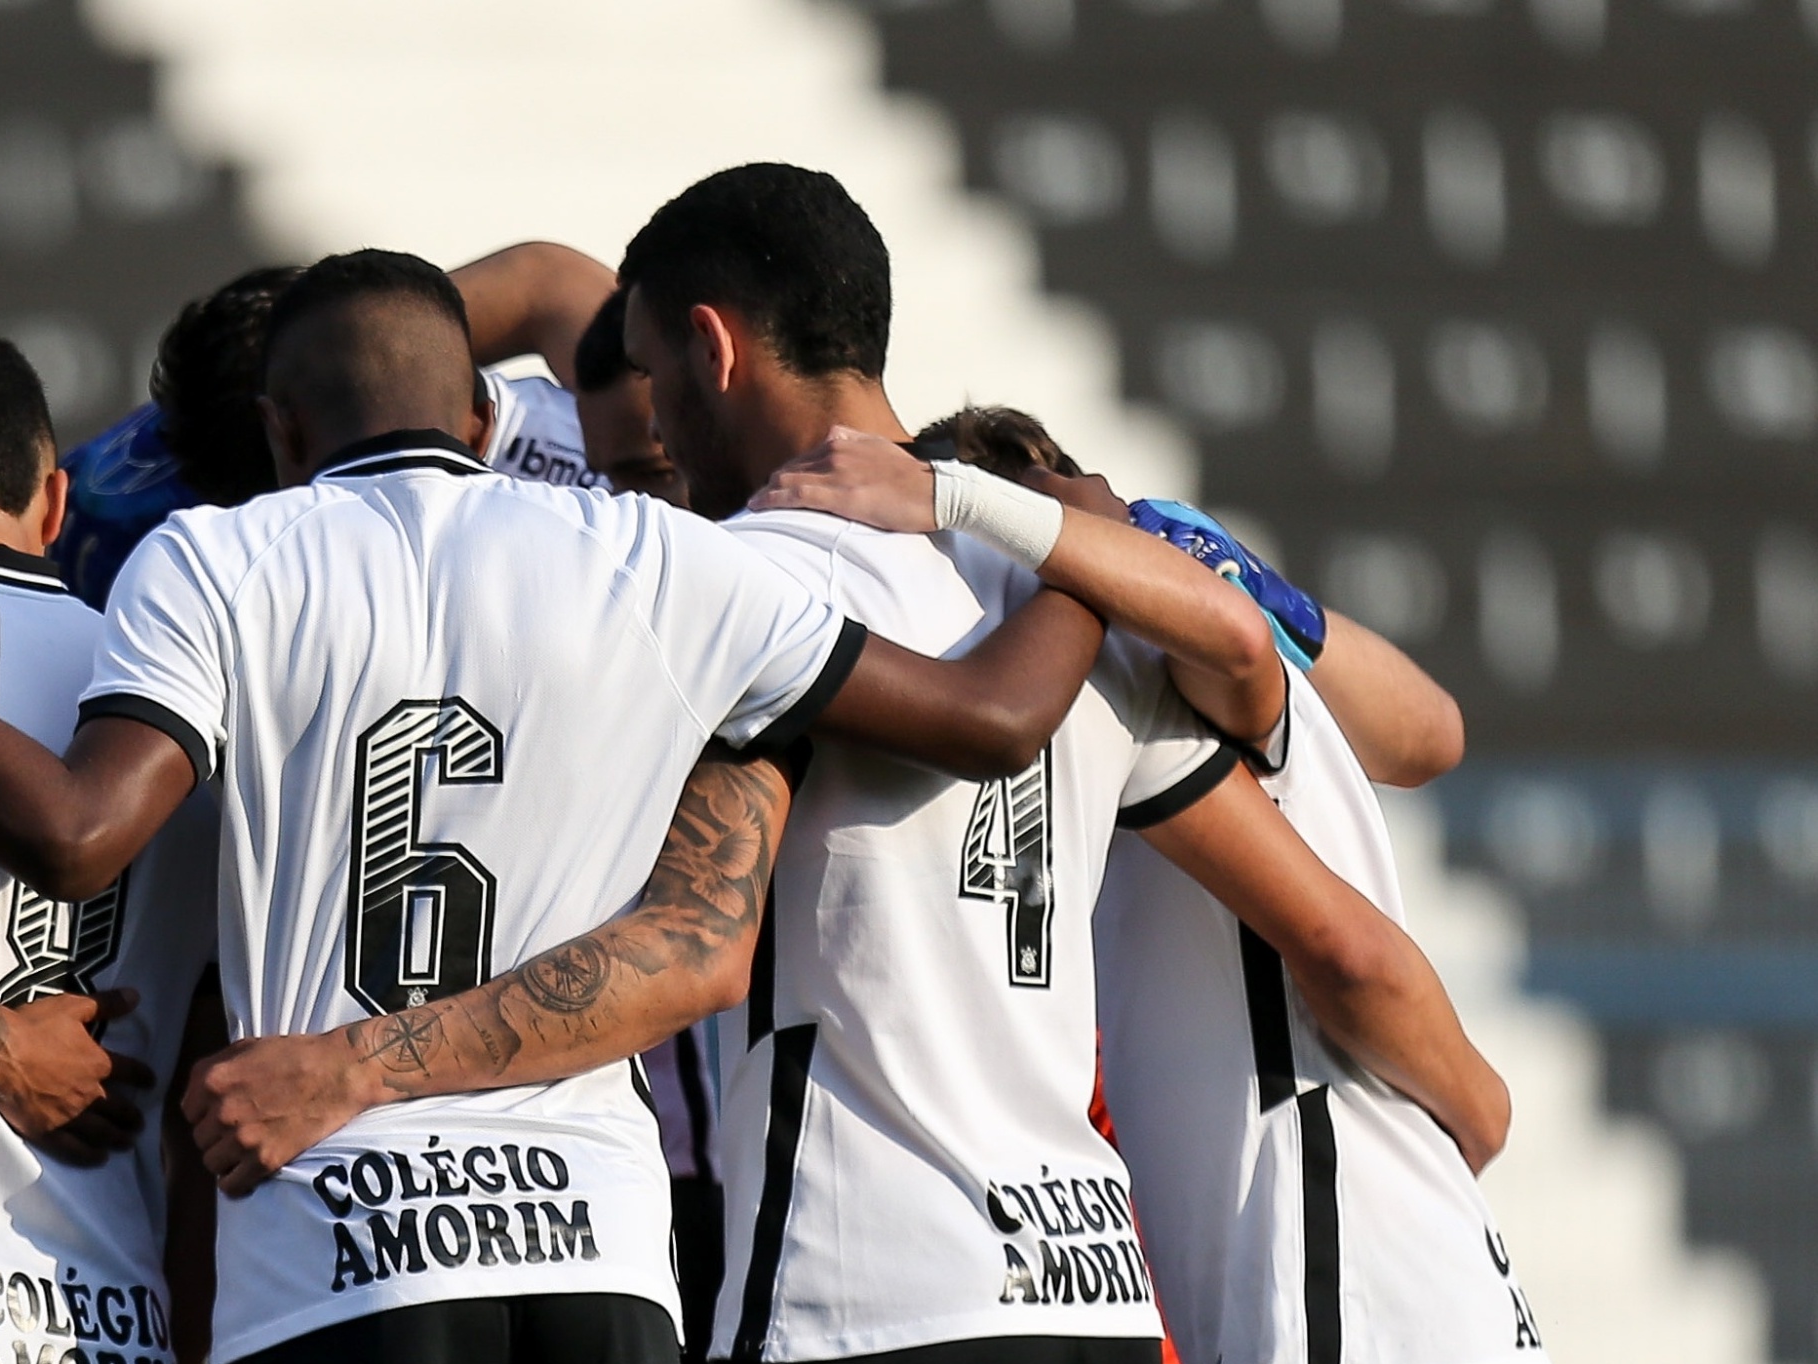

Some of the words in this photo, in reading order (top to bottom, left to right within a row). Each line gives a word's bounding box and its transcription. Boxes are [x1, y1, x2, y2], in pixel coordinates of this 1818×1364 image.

[344, 695, 503, 1016] 6
[958, 748, 1054, 990] 4
[312, 1135, 570, 1218] COLÉGIO
[330, 1200, 601, 1293] AMORIM
